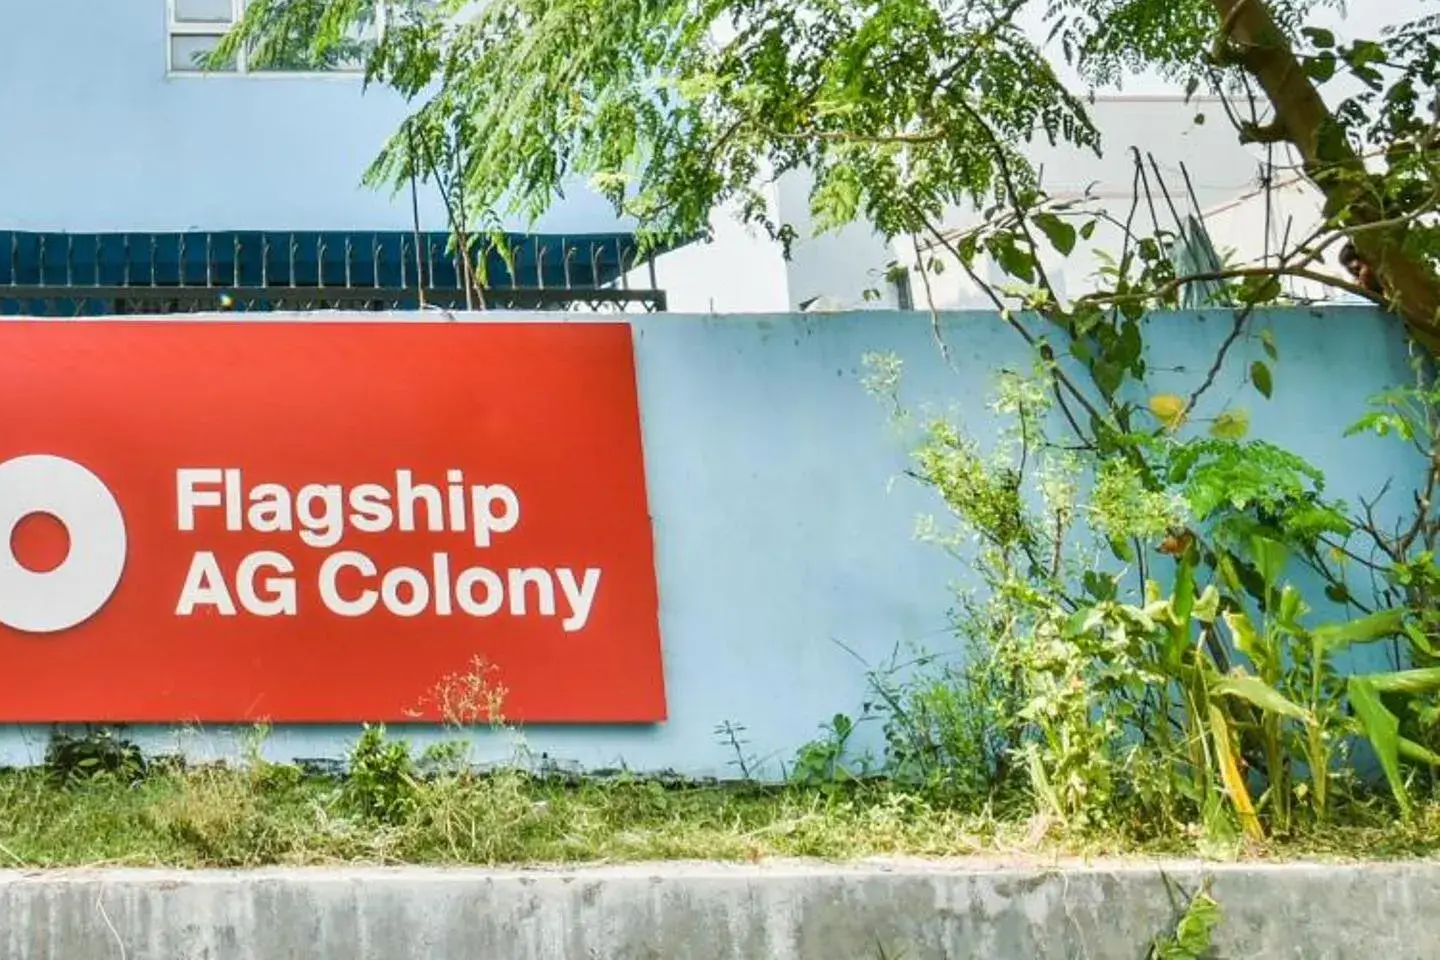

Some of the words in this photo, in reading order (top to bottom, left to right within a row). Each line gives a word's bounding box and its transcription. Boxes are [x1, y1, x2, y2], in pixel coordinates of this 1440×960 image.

[175, 467, 521, 547] Flagship
[174, 550, 298, 617] AG
[317, 550, 602, 632] Colony
